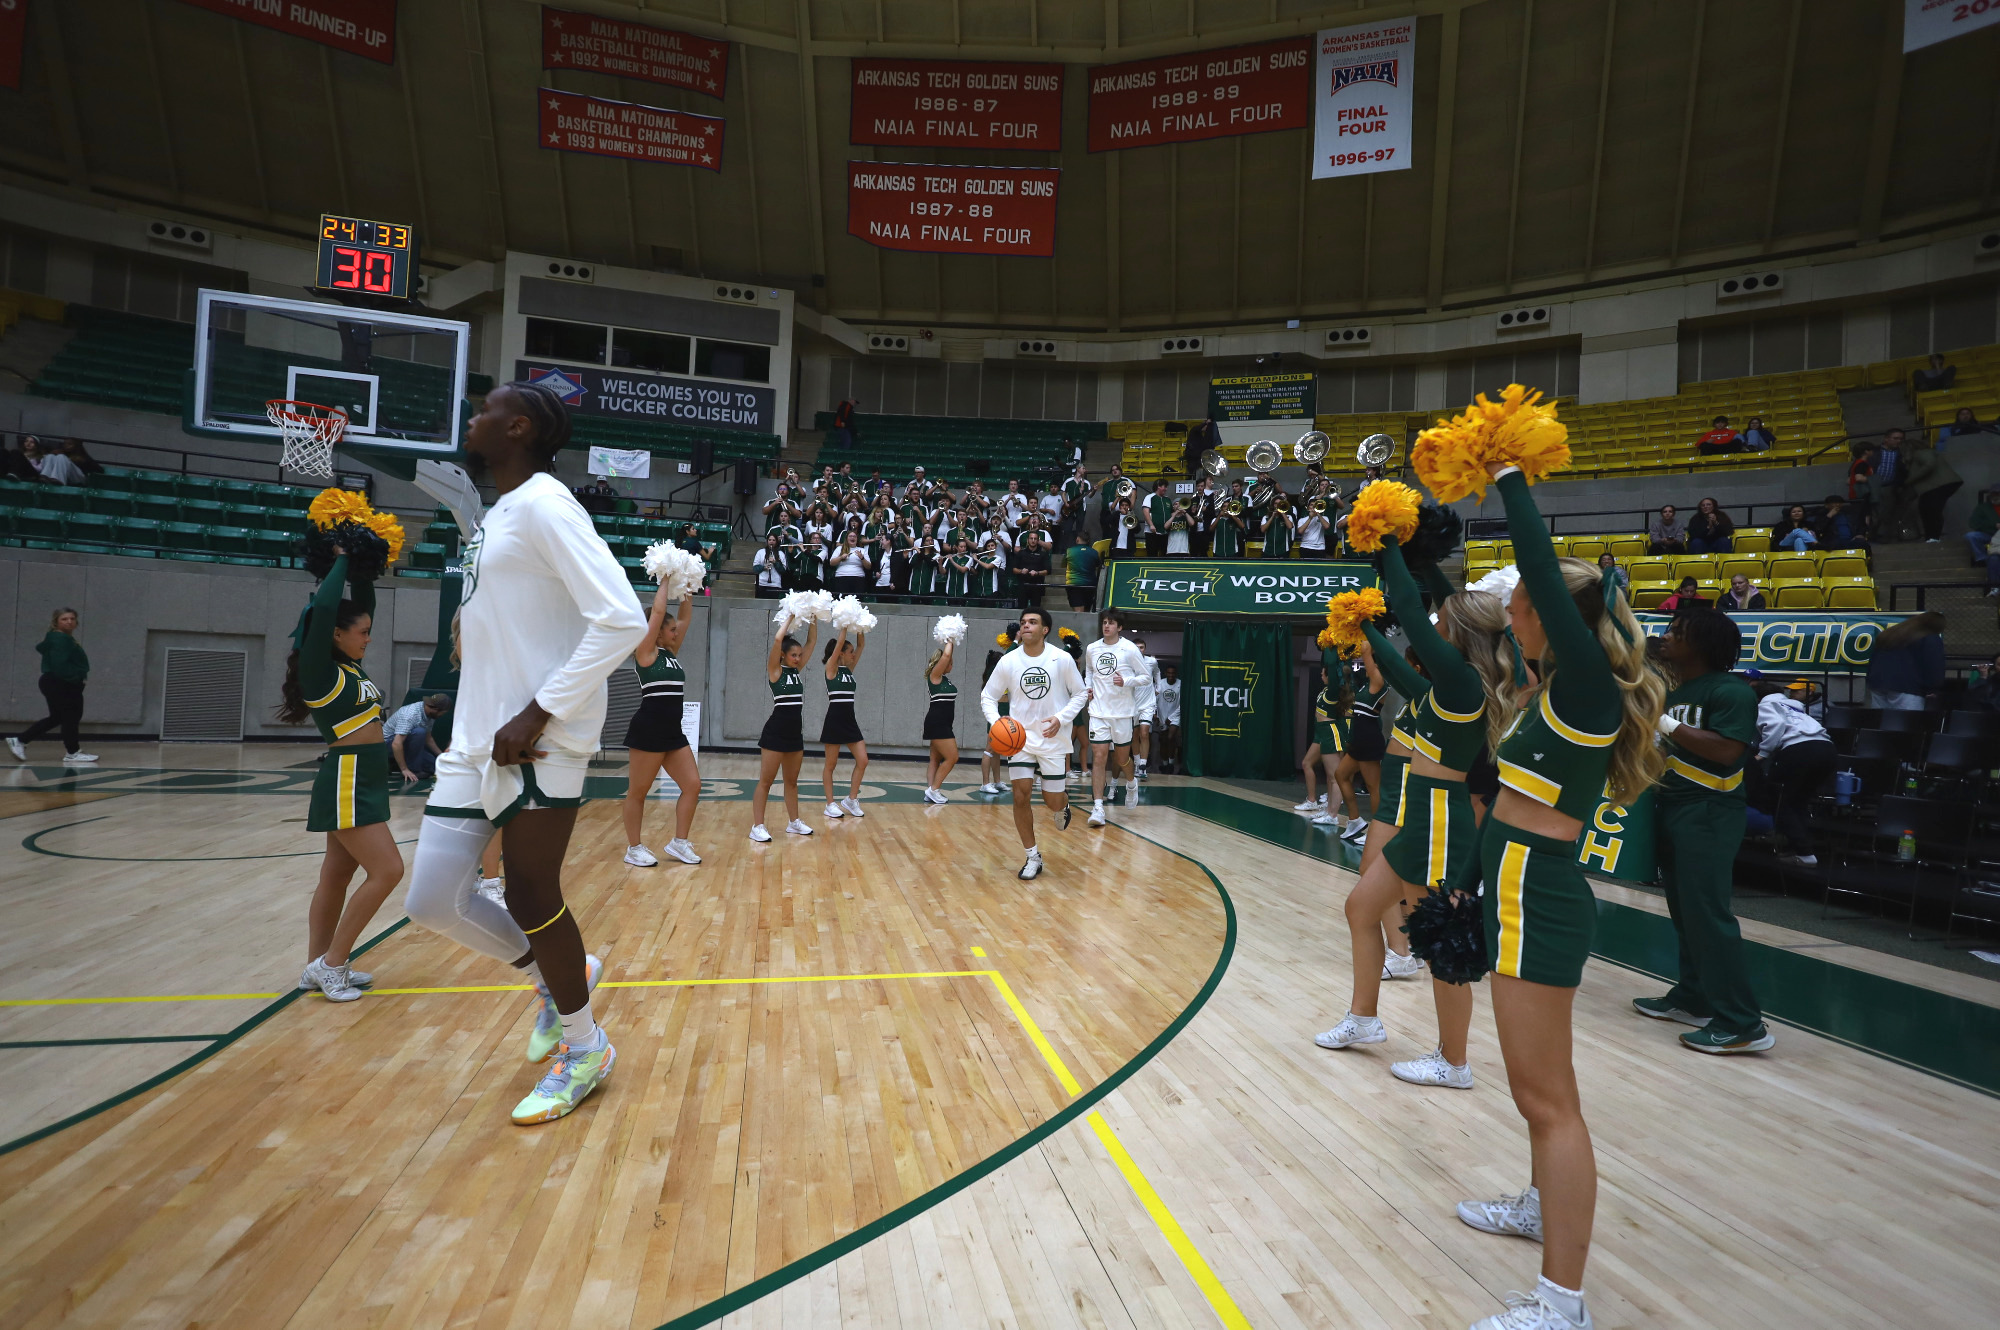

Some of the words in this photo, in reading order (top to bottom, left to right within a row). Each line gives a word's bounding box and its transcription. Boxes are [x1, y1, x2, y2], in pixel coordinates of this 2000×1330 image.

[290, 3, 387, 48] RUNNER-UP
[591, 20, 619, 39] NAIA
[625, 27, 683, 51] NATIONAL
[1322, 30, 1379, 46] ARKANSAS
[1383, 25, 1411, 37] TECH
[560, 33, 637, 58] BASKETBALL
[642, 47, 710, 73] CHAMPIONS
[1322, 44, 1359, 55] WOMEN'S
[1360, 35, 1410, 50] BASKETBALL
[570, 51, 599, 67] 1992
[603, 56, 648, 75] WOMEN'S
[652, 66, 692, 84] DIVISION
[1093, 71, 1156, 94] ARKANSAS
[1164, 65, 1198, 84] TECH
[1206, 55, 1261, 78] GOLDEN
[1270, 50, 1307, 70] SUNS
[1333, 61, 1395, 91] NAIA
[857, 70, 920, 87] ARKANSAS
[927, 73, 960, 89] TECH
[966, 73, 1017, 90] GOLDEN
[1023, 75, 1059, 91] SUNS
[587, 103, 615, 120] NAIA
[621, 109, 678, 131] NATIONAL
[1110, 120, 1151, 139] NAIA
[1162, 111, 1219, 132] FINAL
[1230, 103, 1282, 124] FOUR
[1337, 105, 1388, 121] FINAL
[557, 114, 632, 139] BASKETBALL
[637, 127, 705, 150] CHAMPIONS
[874, 118, 915, 135] NAIA
[926, 120, 979, 137] FINAL
[989, 122, 1038, 139] FOUR
[1339, 120, 1386, 136] FOUR
[567, 132, 595, 149] 1993
[599, 138, 644, 155] WOMEN'S
[647, 146, 688, 161] DIVISION
[691, 151, 695, 161] I
[1329, 148, 1395, 166] 1996-97
[853, 173, 915, 192] ARKANSAS
[924, 176, 957, 194] TECH
[964, 179, 1014, 196] GOLDEN
[1020, 180, 1054, 197] SUNS
[870, 221, 911, 240] NAIA
[921, 225, 973, 242] FINAL
[983, 227, 1031, 244] FOUR
[333, 248, 392, 292] 30
[1240, 374, 1305, 384] CHAMPIONS
[602, 378, 693, 402] WELCOMES
[697, 389, 730, 406] YOU
[734, 393, 756, 408] TO
[598, 395, 667, 416] TUCKER
[672, 404, 759, 425] COLISEUM
[202, 421, 230, 429] SPALDING
[1136, 578, 1212, 593] TECH
[1230, 575, 1361, 588] WONDER
[1254, 591, 1333, 604] BOYS
[1738, 621, 1899, 664] ECTIO
[1024, 676, 1046, 684] TECH
[1200, 686, 1248, 708] TECH
